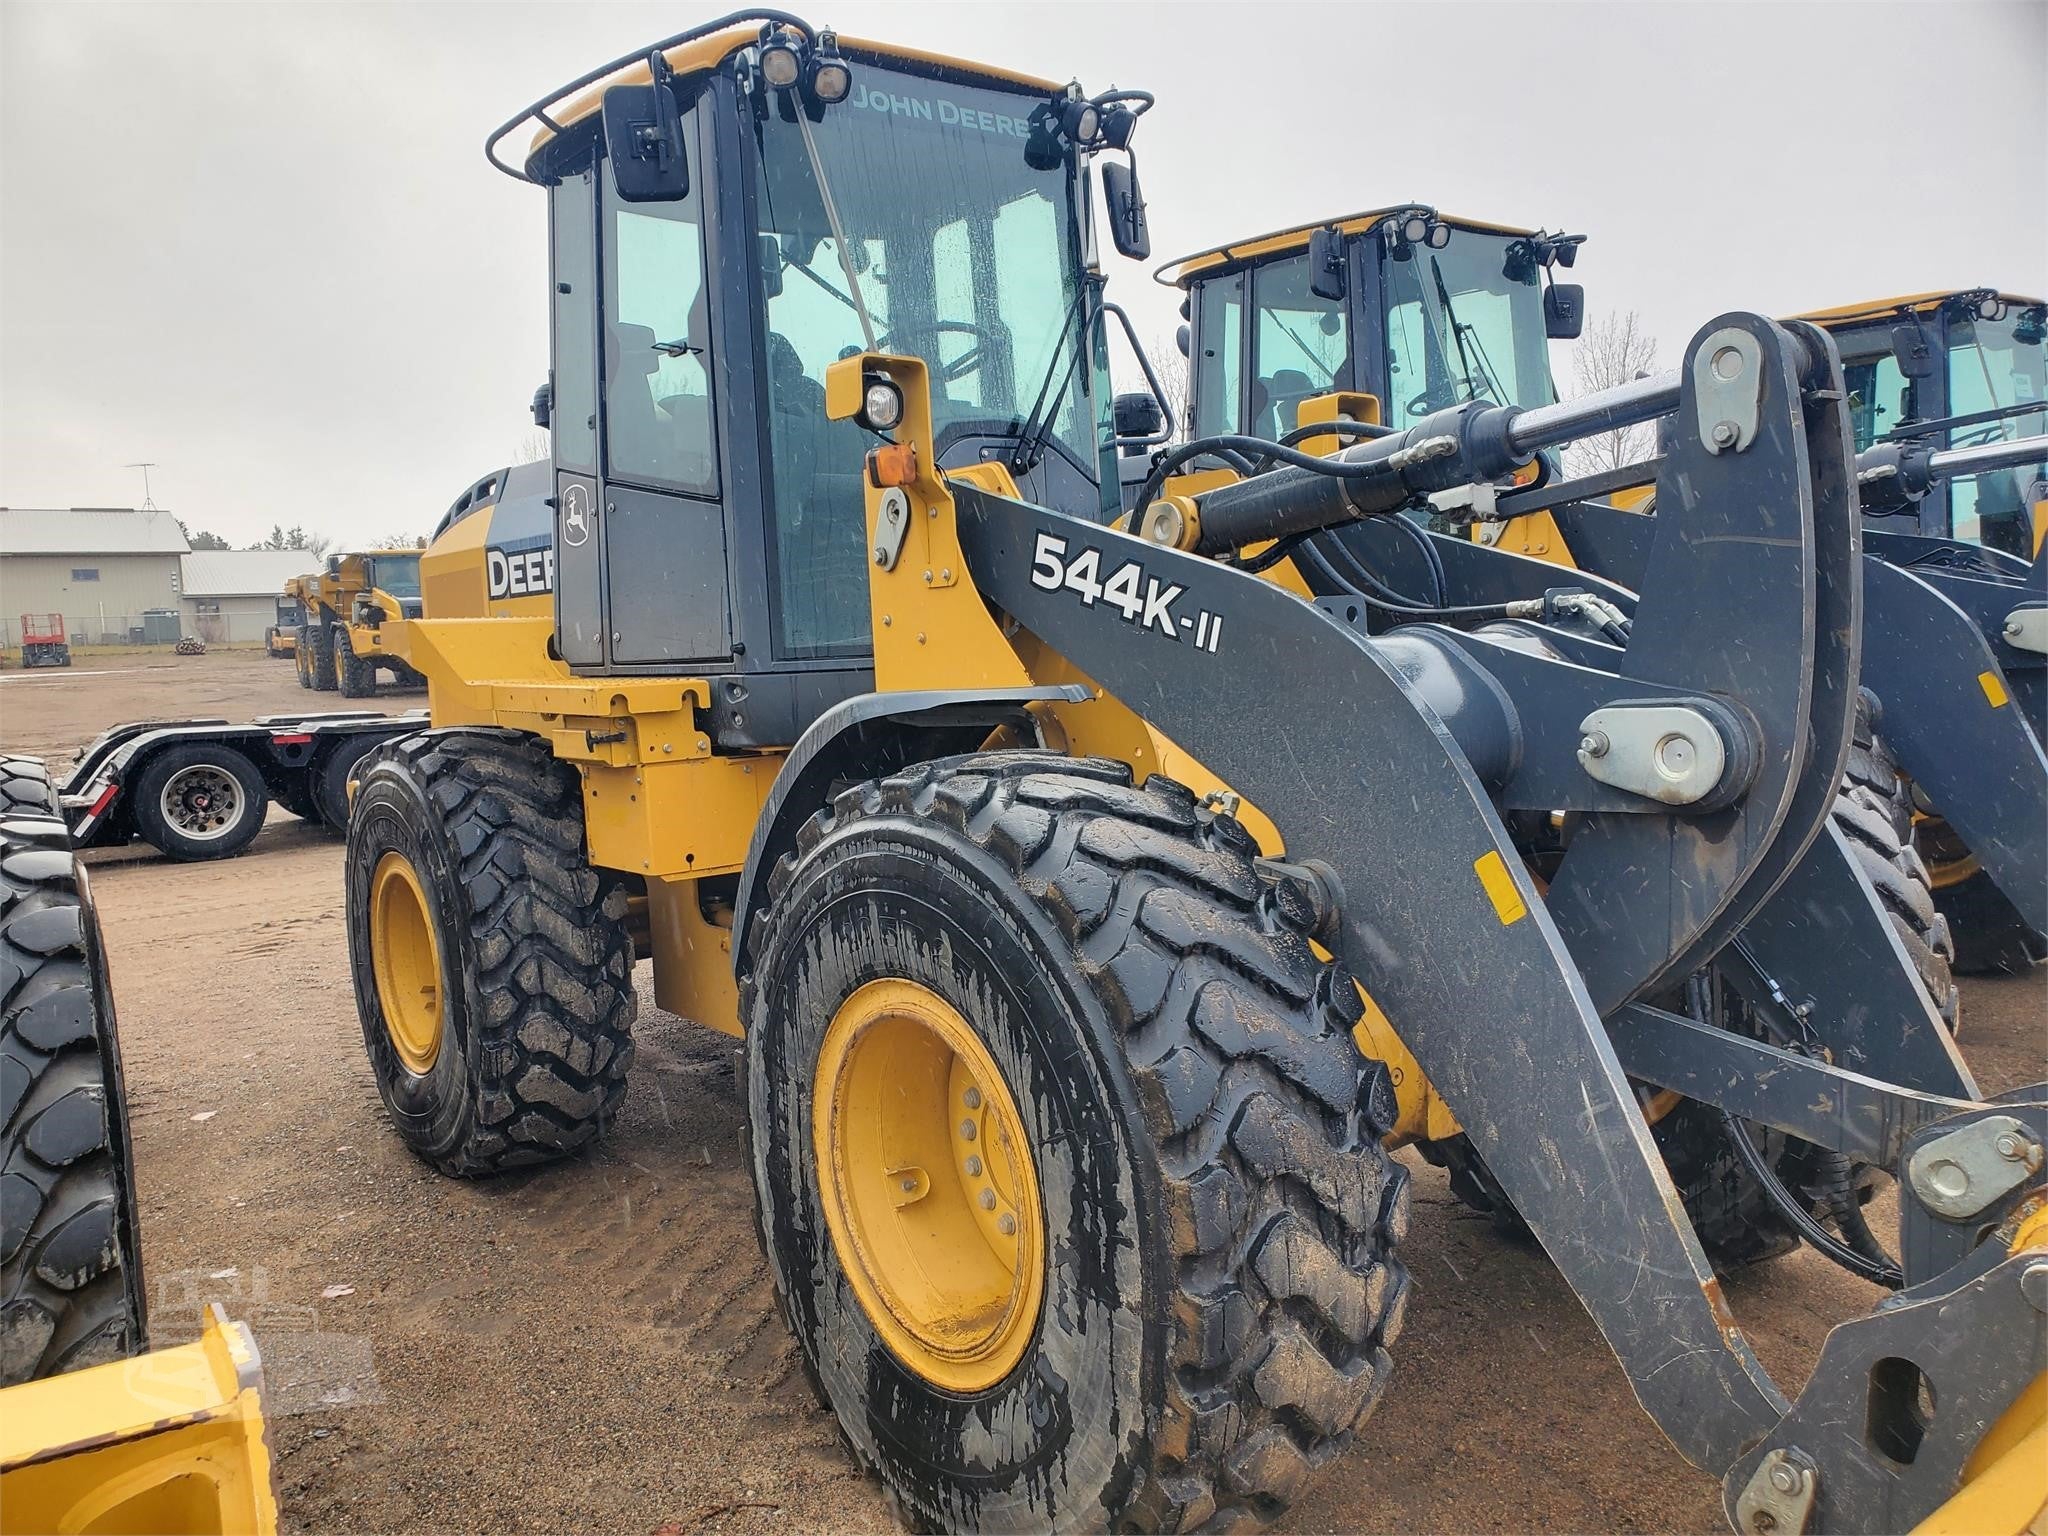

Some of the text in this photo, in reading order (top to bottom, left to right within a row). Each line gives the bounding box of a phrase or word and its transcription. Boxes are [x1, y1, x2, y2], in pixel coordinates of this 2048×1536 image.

[853, 84, 1031, 139] JOHN DEERE
[1032, 533, 1222, 653] 544K-II
